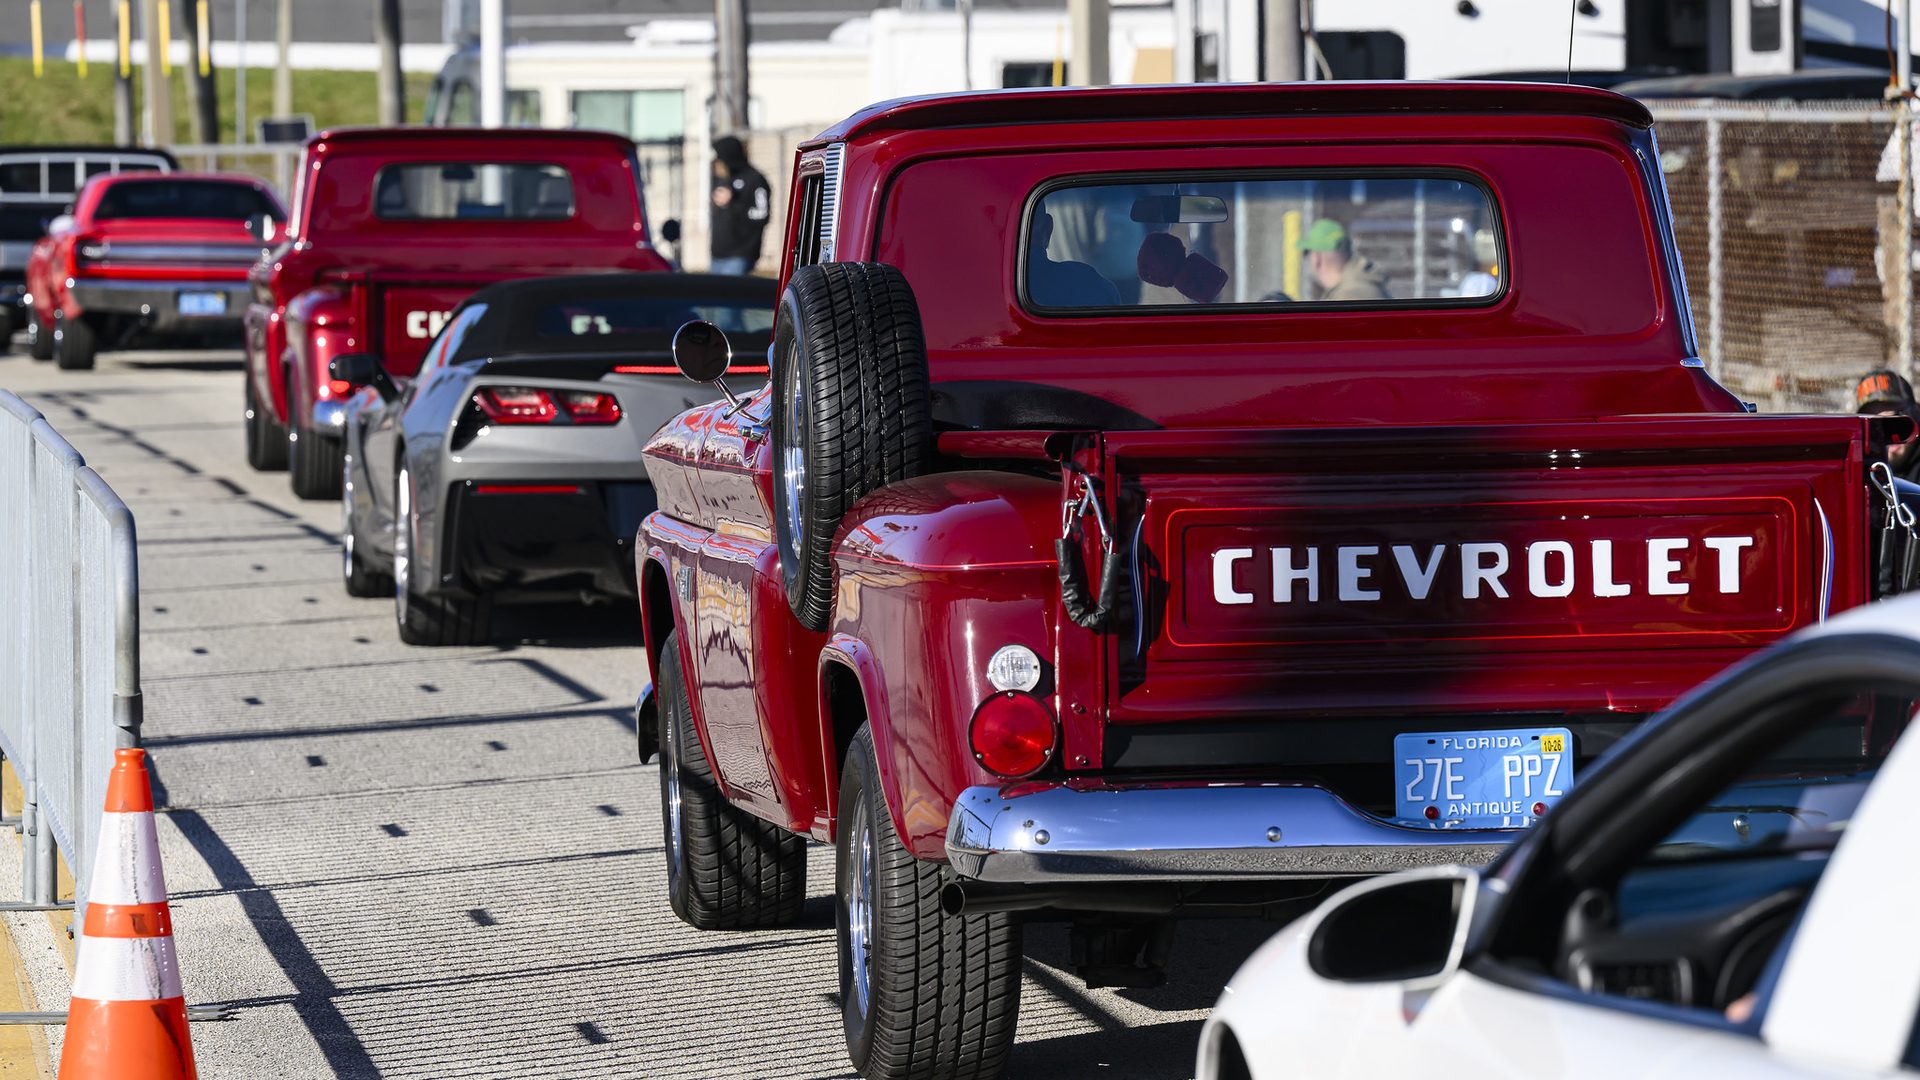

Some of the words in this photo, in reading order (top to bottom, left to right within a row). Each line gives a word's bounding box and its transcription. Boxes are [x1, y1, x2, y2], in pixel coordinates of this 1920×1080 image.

[1211, 536, 1754, 604] CHEVROLET
[1442, 736, 1523, 750] FLORIDA
[1544, 740, 1562, 751] 10-26
[1405, 757, 1465, 801] 27E
[1503, 754, 1564, 798] PPZ
[1448, 801, 1523, 816] ANTIQUE
